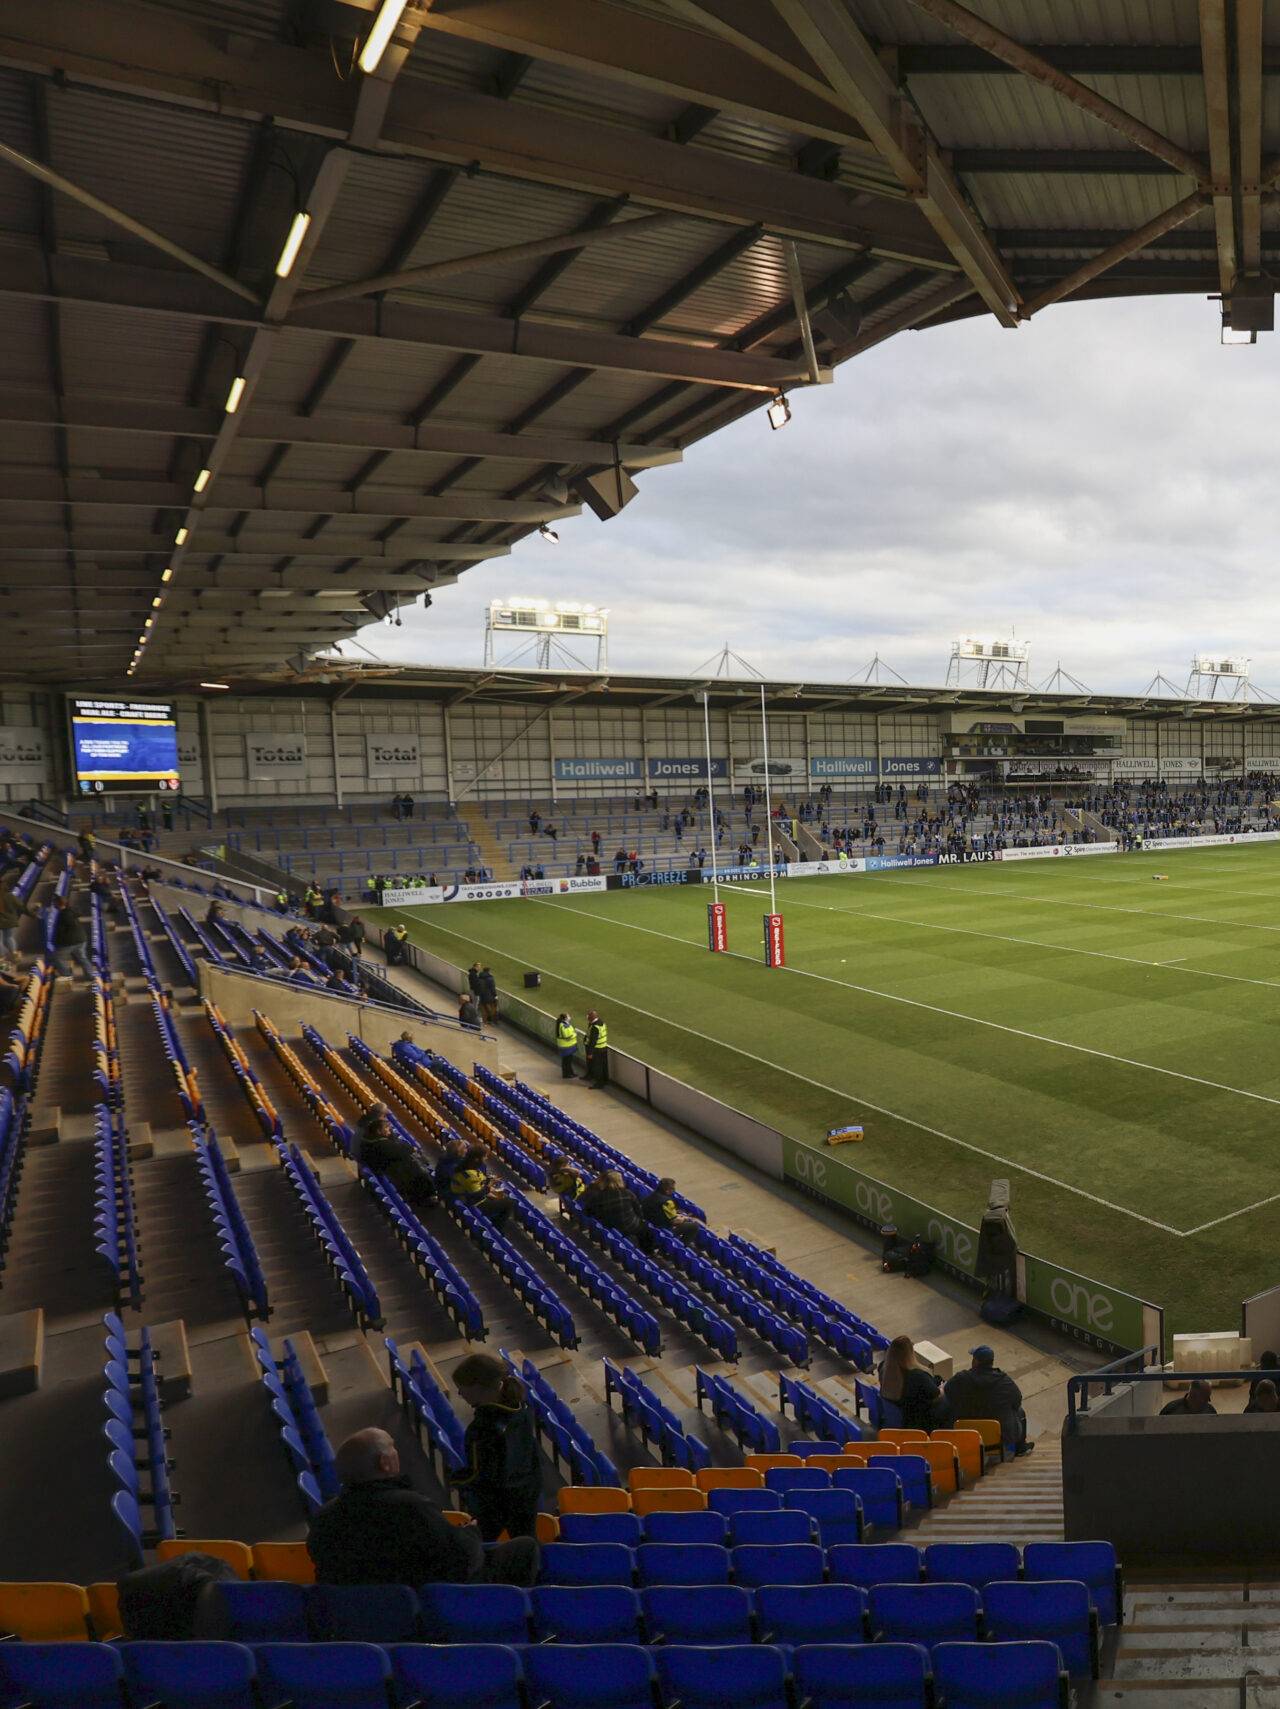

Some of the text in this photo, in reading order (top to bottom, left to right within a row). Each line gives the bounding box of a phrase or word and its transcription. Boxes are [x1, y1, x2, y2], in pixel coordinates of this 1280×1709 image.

[251, 747, 303, 762] Total
[371, 747, 417, 761] Total
[562, 762, 700, 776] Halliwell Jones
[816, 760, 920, 773] Halliwell Jones
[1116, 760, 1183, 769] HALLIWELL JONES
[881, 855, 934, 868] Halliwell Jones
[939, 850, 994, 864] MR. LAU'S
[570, 879, 602, 888] Bubble
[703, 871, 787, 884] BADRHINO.COM
[795, 1149, 827, 1188] one
[856, 1180, 894, 1223] one
[928, 1219, 973, 1266] one
[1050, 1277, 1114, 1332] one
[1050, 1318, 1116, 1353] ENERGY
